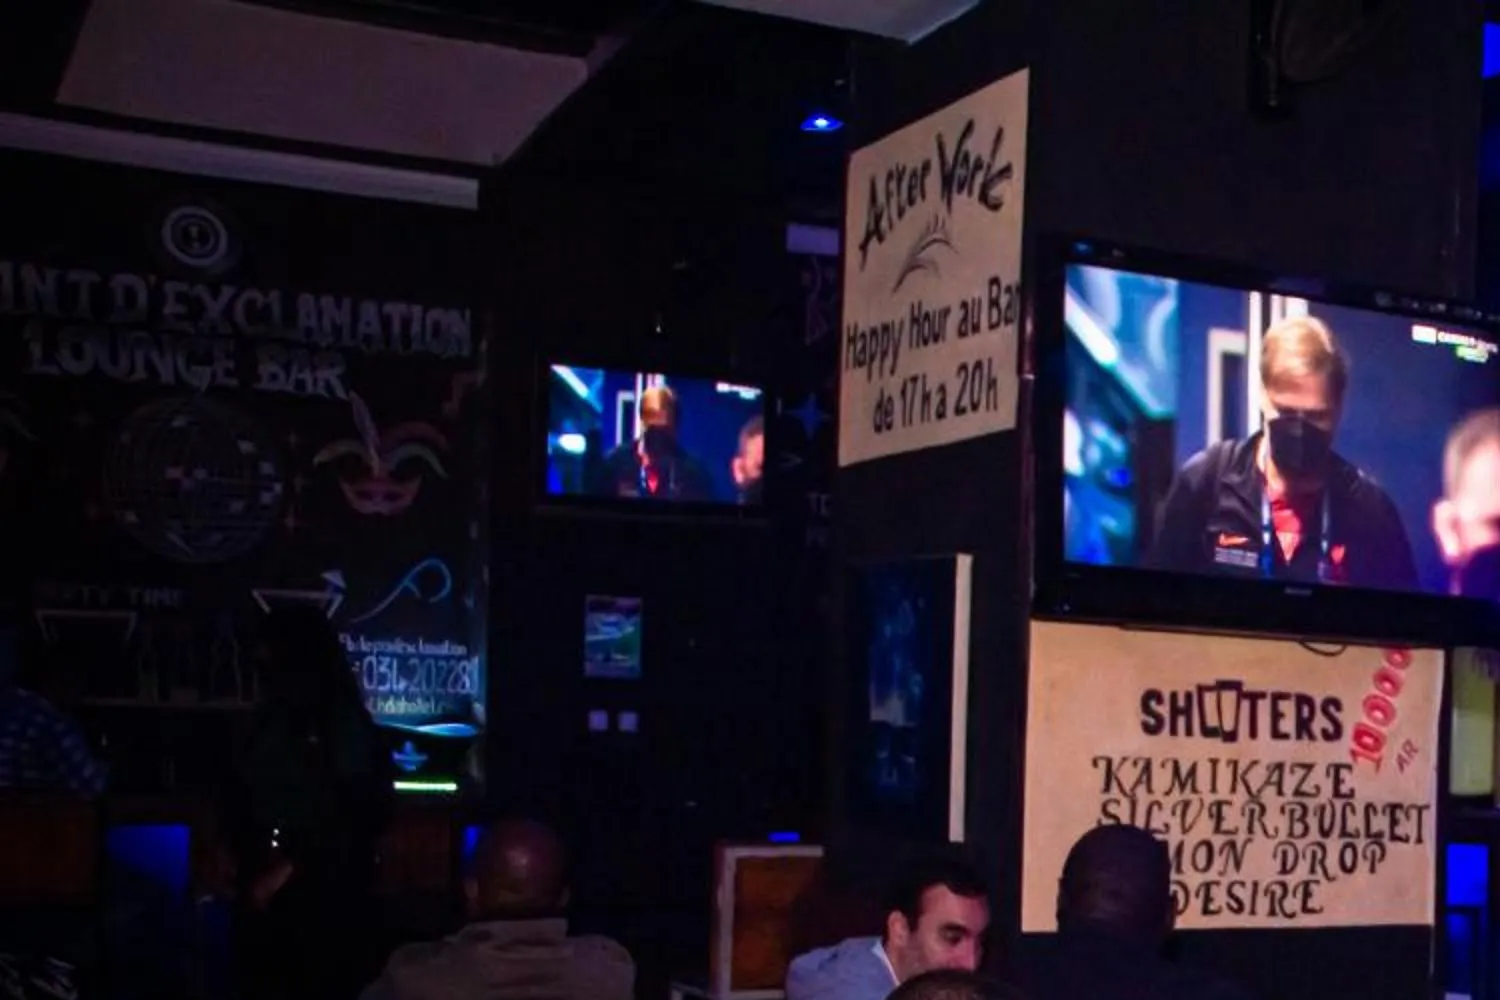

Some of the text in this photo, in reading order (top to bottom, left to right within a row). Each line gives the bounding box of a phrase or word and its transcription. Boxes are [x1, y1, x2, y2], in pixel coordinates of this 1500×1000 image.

[858, 118, 1013, 271] After Work
[23, 320, 350, 400] LOUNGE BAR
[845, 320, 902, 384] Happy
[909, 299, 950, 350] Hour
[958, 299, 983, 338] au
[874, 387, 894, 434] de
[955, 357, 998, 417] 20h
[1092, 755, 1356, 799] KAMIKAZE
[1273, 841, 1387, 882] DROP
